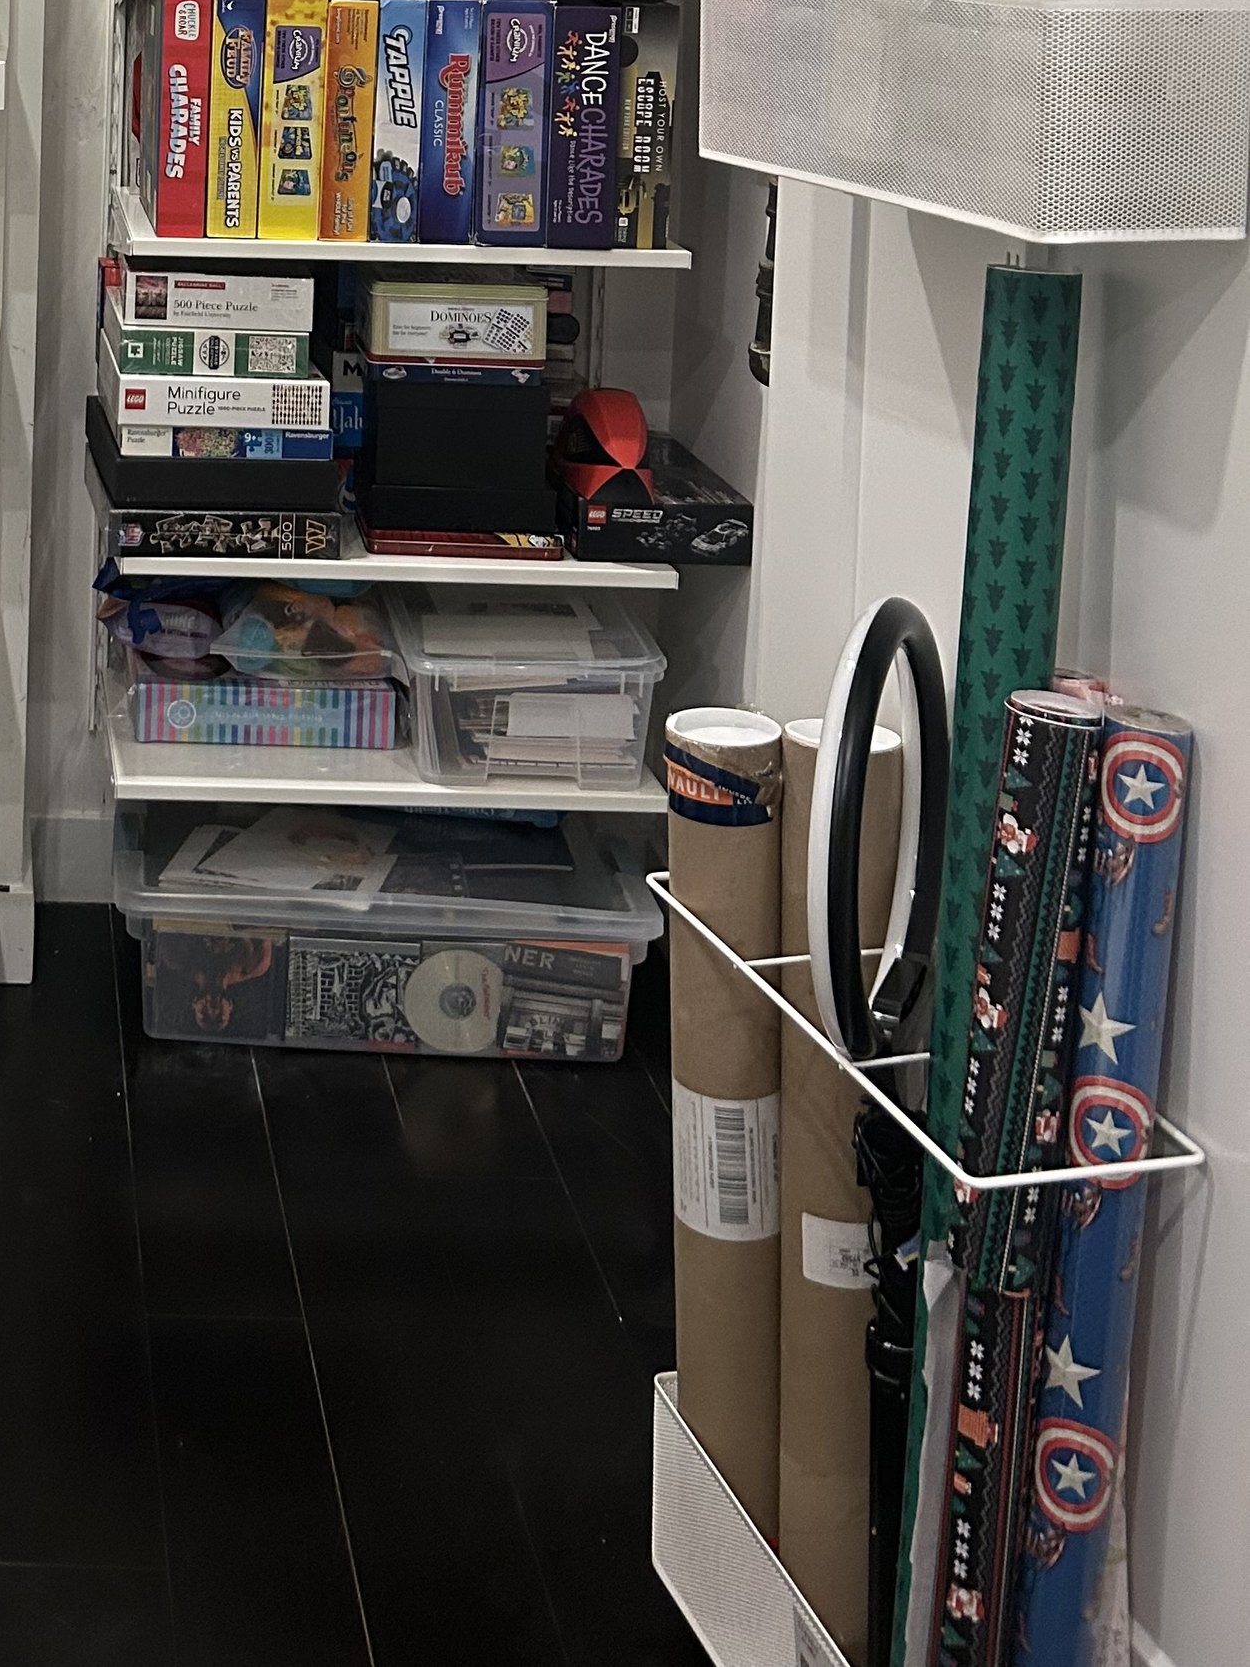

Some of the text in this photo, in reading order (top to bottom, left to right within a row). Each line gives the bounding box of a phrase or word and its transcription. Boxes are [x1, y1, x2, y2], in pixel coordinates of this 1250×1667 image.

[225, 34, 240, 79] FEUD
[236, 29, 254, 84] FAMILY
[383, 34, 417, 129] TAPPLE
[166, 64, 188, 179] CHARADES
[189, 98, 202, 147] FAMILY
[433, 100, 445, 147] CLASSIC
[439, 53, 471, 196] Rummikub
[575, 32, 610, 225] DANCE CHARADES
[654, 80, 667, 173] HOST YOUR OWN
[225, 109, 243, 228] KIDS PARENTS
[173, 299, 258, 312] 500 Piece Puzzle
[430, 310, 492, 324] DOMINOES
[126, 387, 241, 404] LEGO Minifigure
[167, 401, 215, 416] Puzzle
[244, 433, 257, 442] 9+
[264, 437, 274, 455] 300
[285, 432, 330, 440] Ravensburger
[281, 521, 292, 551] 500
[589, 508, 663, 521] LEGO SPEED
